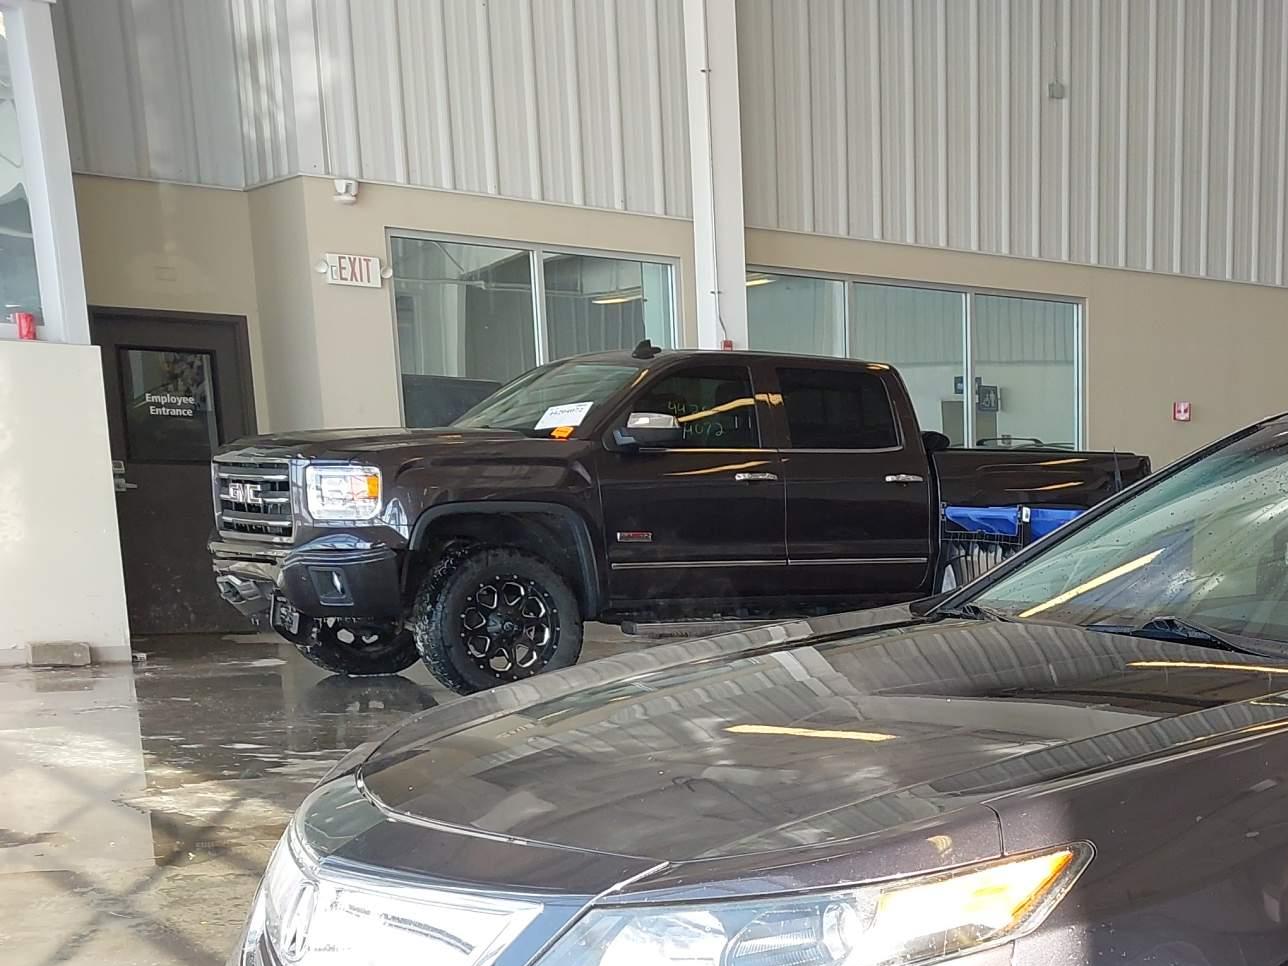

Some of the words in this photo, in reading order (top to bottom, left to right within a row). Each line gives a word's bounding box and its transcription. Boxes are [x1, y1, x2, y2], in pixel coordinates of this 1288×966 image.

[338, 255, 371, 283] EXIT
[145, 393, 194, 405] Employee
[149, 406, 193, 416] Entrance
